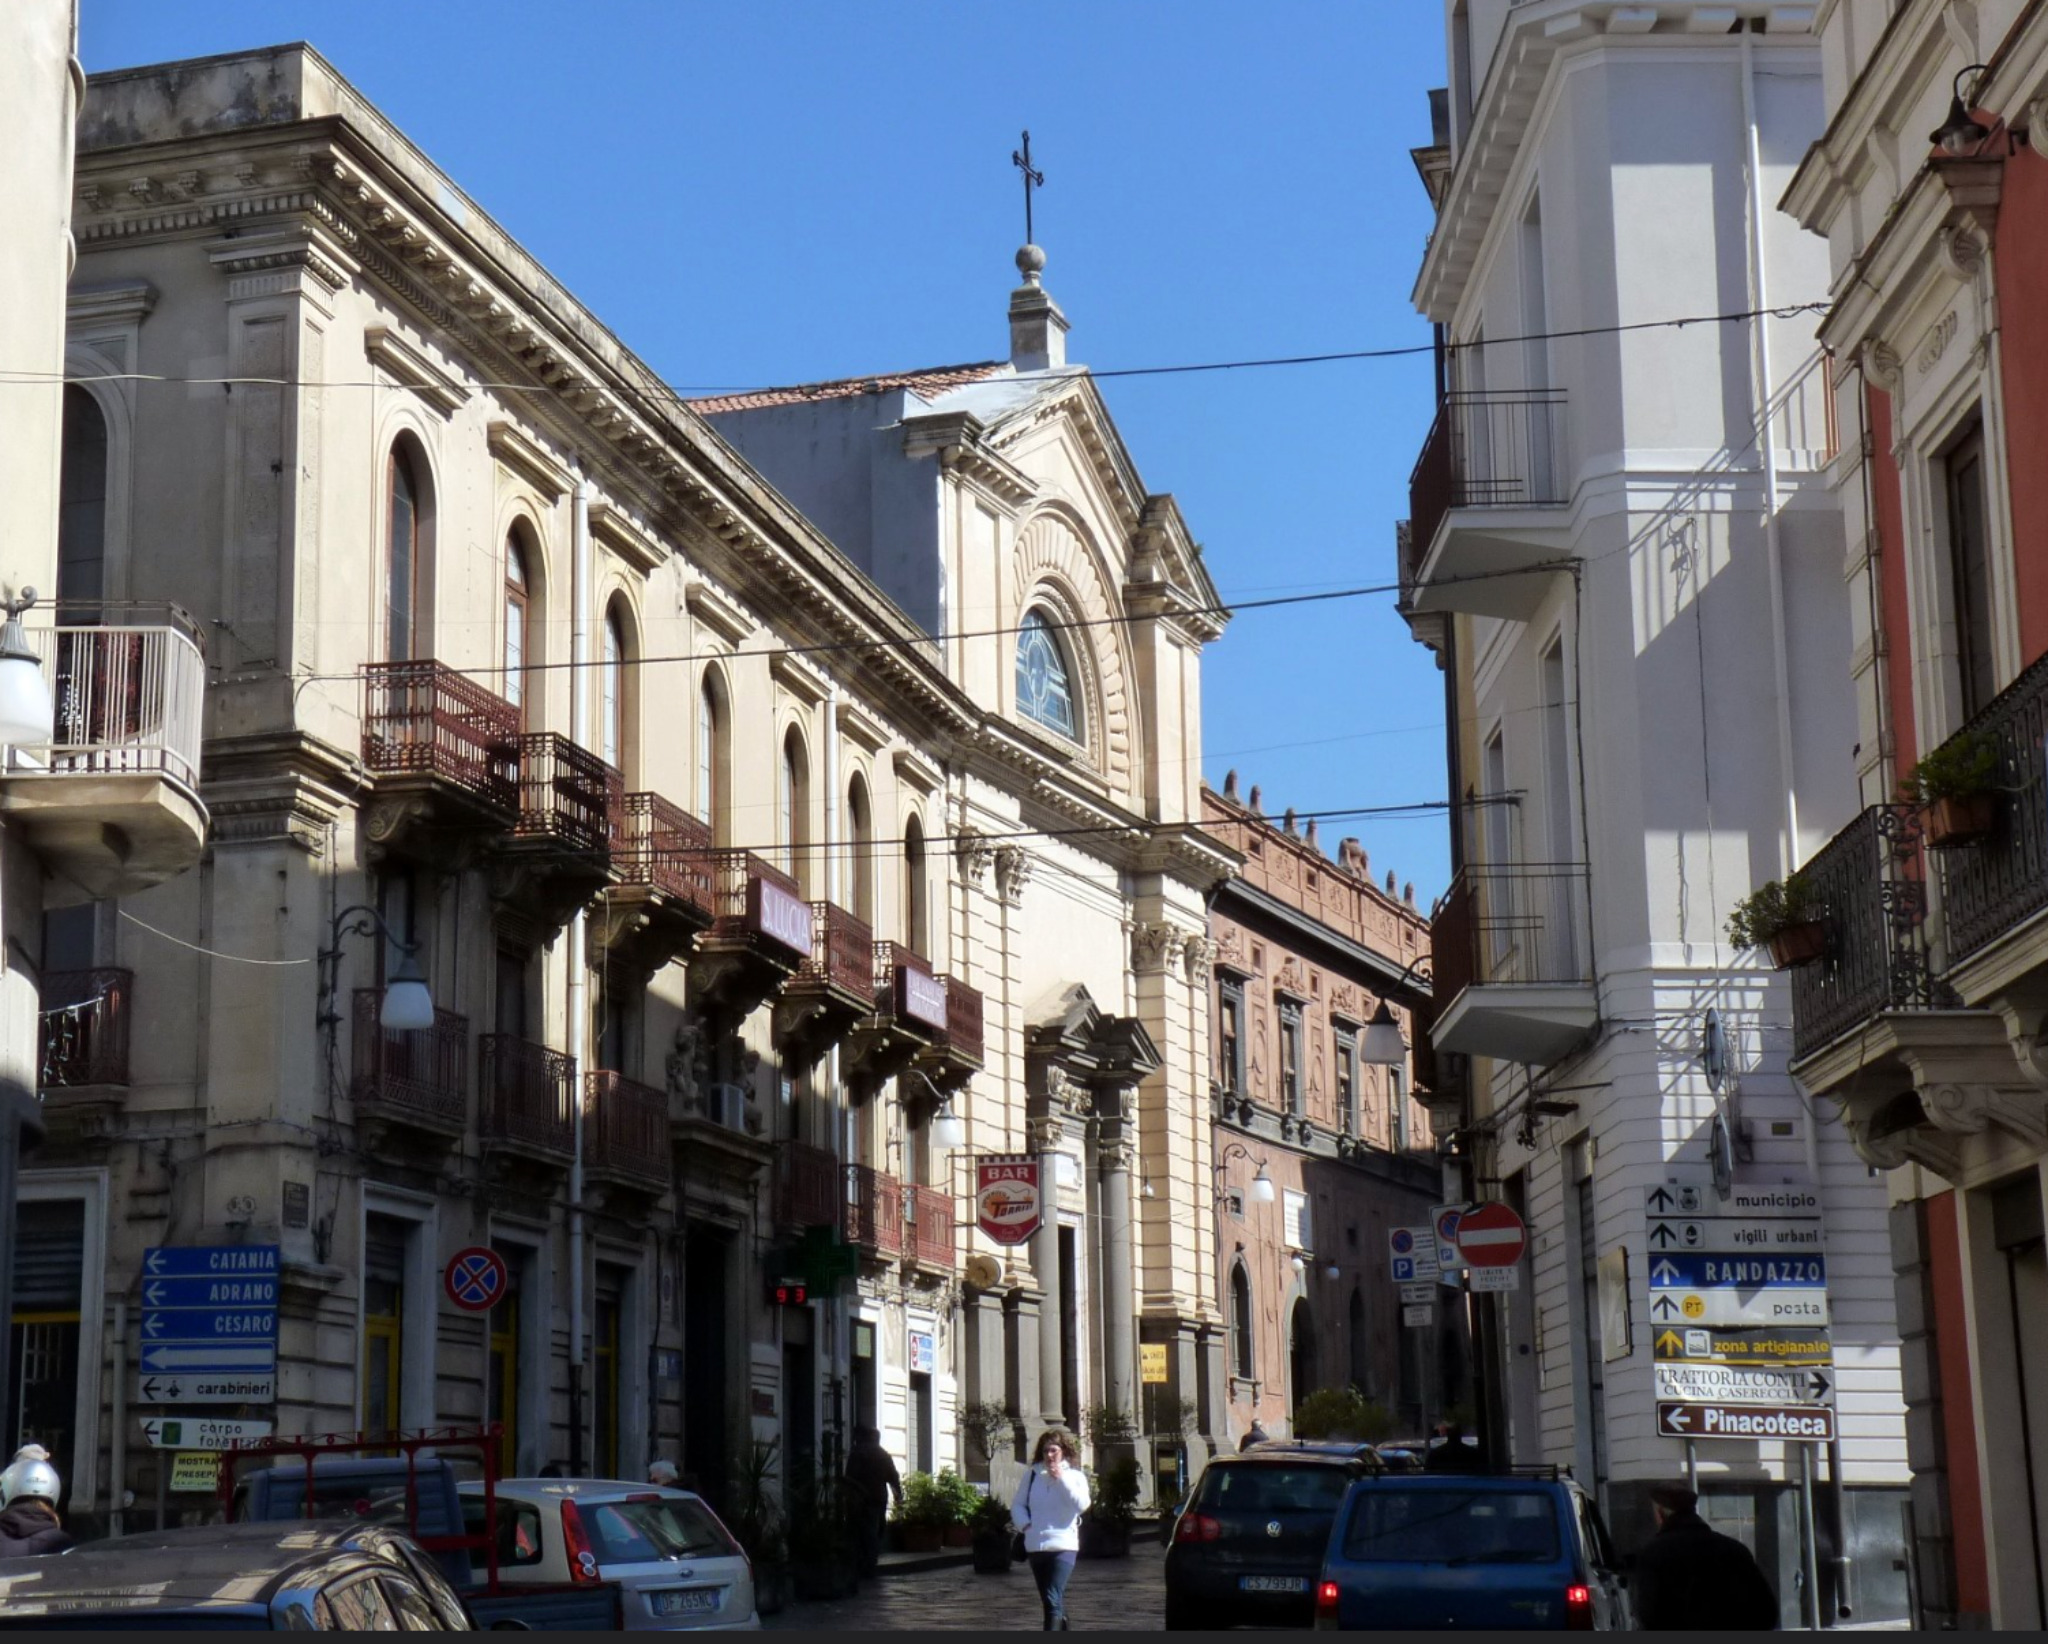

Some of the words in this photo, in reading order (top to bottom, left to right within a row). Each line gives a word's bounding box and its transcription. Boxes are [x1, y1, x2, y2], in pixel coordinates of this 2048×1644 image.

[987, 1166, 1029, 1180] BAR
[1736, 1193, 1816, 1210] municipio
[1733, 1229, 1767, 1245] vigili
[1776, 1229, 1818, 1243] urbani
[209, 1251, 275, 1269] CATANIA
[1397, 1261, 1409, 1277] P
[1705, 1262, 1820, 1281] RANDAZZO
[209, 1284, 274, 1301] ADRANO
[1685, 1302, 1701, 1312] PT
[1773, 1302, 1821, 1316] posta
[1714, 1340, 1748, 1353] zona
[1752, 1340, 1829, 1356] artigianale
[1656, 1368, 1749, 1386] TRATTORIA
[1752, 1372, 1806, 1388] CONTI
[197, 1381, 270, 1395] carabinieri
[1664, 1384, 1714, 1397] CUCINA
[1717, 1386, 1801, 1399] CASERECCIA
[199, 1423, 242, 1435] corpo
[1704, 1409, 1827, 1436] Pinacoteca
[178, 1457, 217, 1466] MOSTRA
